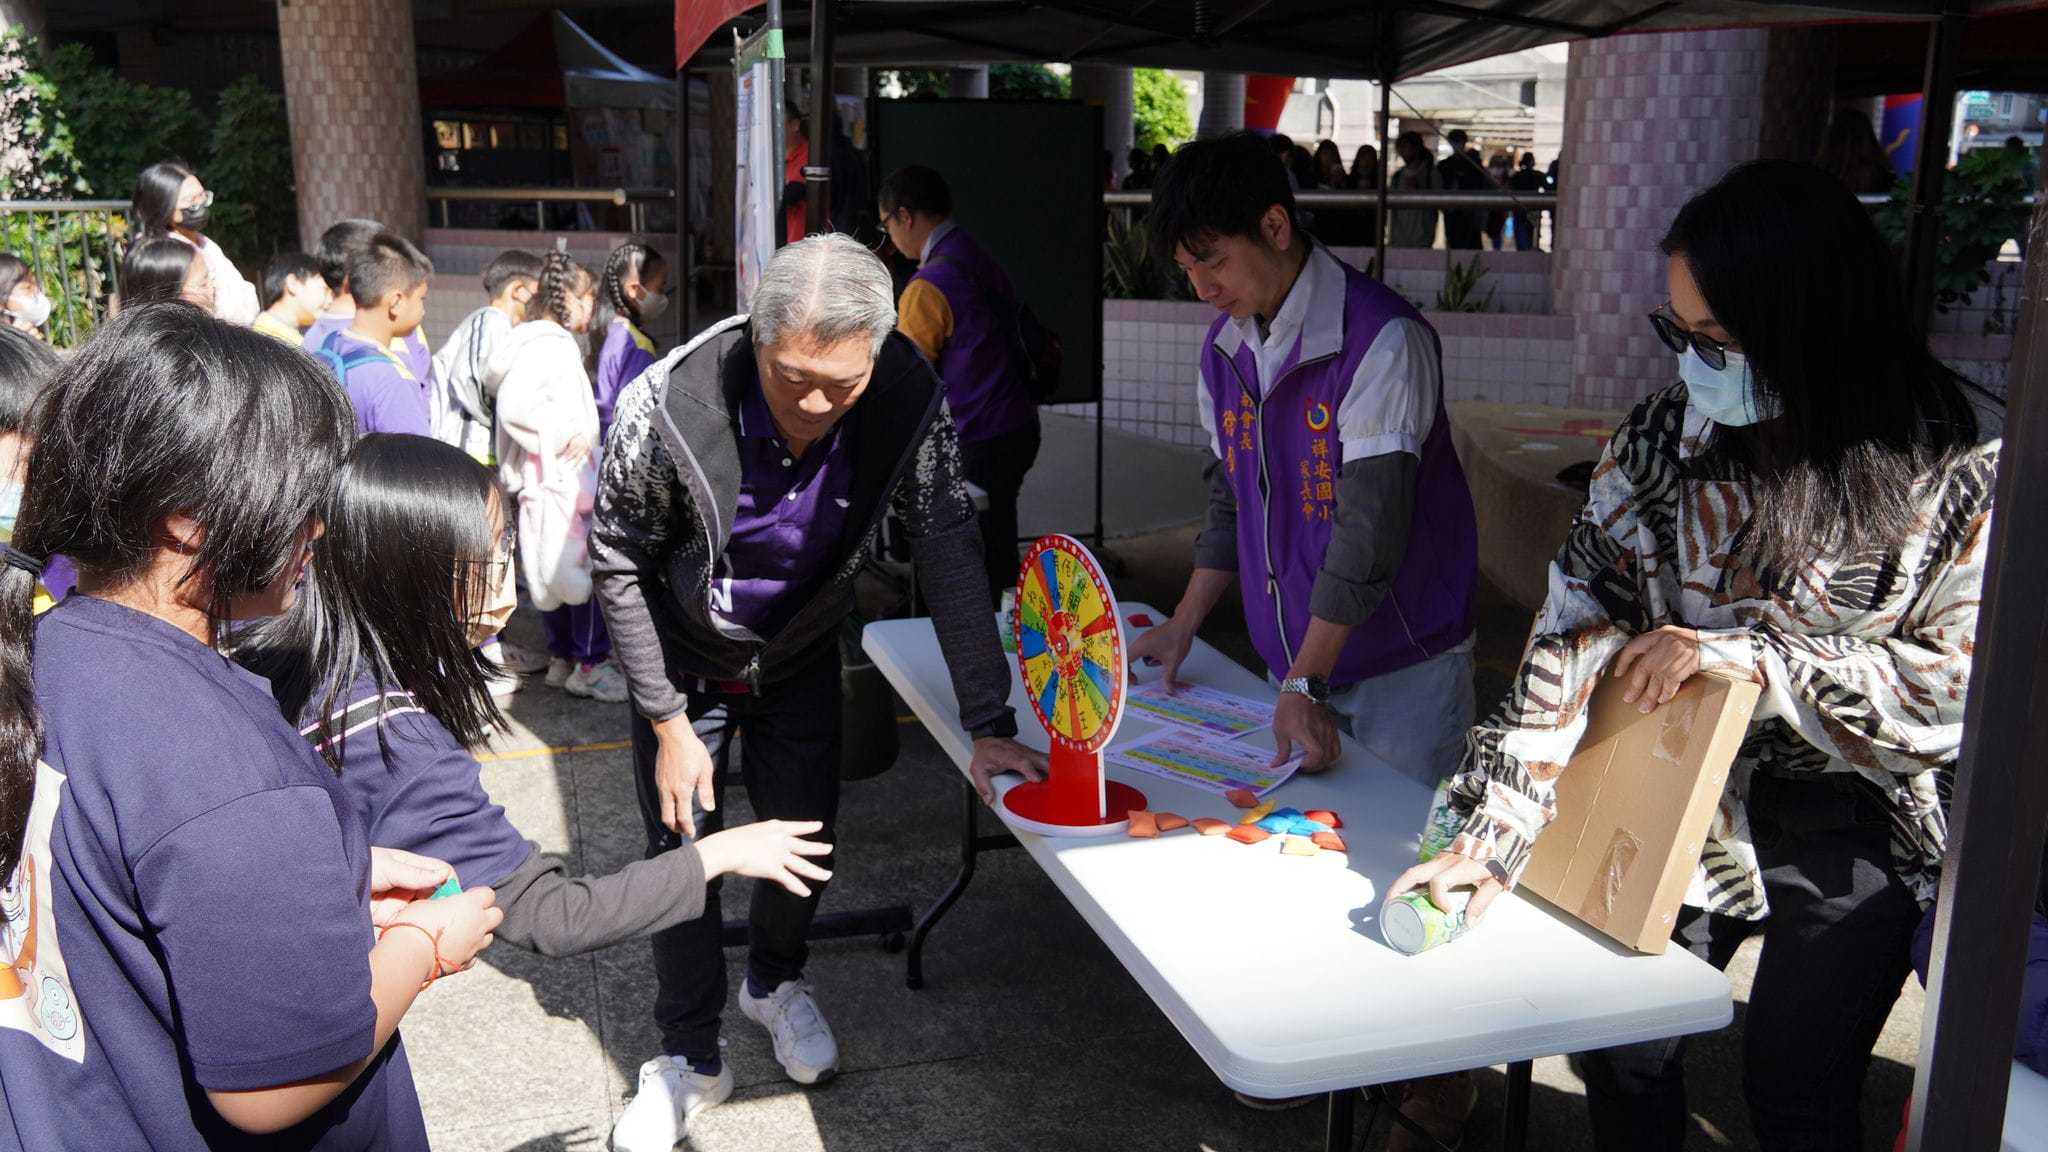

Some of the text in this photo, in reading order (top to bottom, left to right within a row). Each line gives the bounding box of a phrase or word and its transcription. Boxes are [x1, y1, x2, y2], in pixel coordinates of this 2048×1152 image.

[1300, 460, 1314, 520] 家長會
[1312, 438, 1332, 521] 祥安國小
